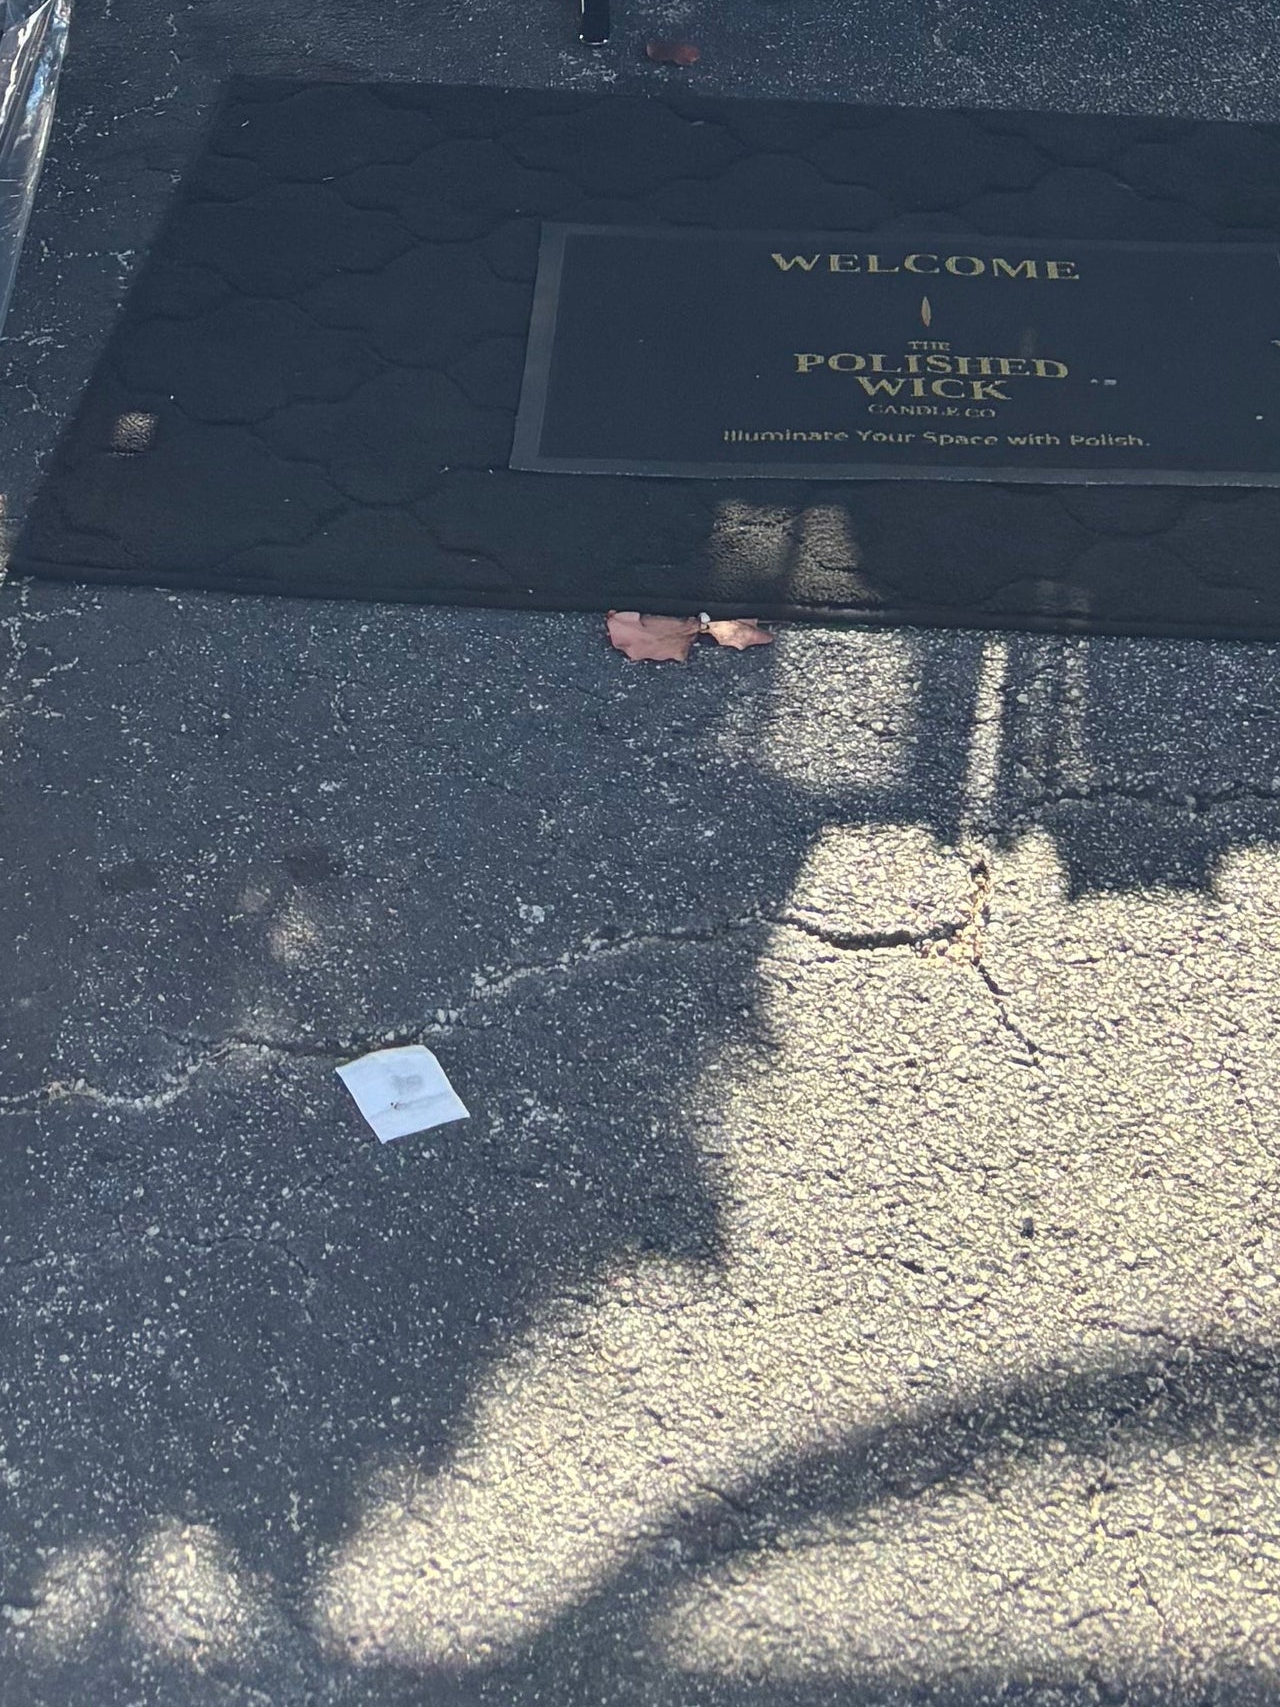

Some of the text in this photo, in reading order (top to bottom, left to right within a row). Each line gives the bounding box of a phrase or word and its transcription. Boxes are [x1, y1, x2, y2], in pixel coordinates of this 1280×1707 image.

[770, 250, 1080, 282] WELCOME
[907, 340, 951, 352] THE
[793, 353, 1069, 379] POLISHED
[855, 376, 1012, 401] WICK
[868, 403, 961, 418] CANDLE
[723, 429, 849, 443] Illuminate
[856, 429, 916, 444] Your
[922, 431, 999, 447] Space
[1007, 433, 1060, 447] with
